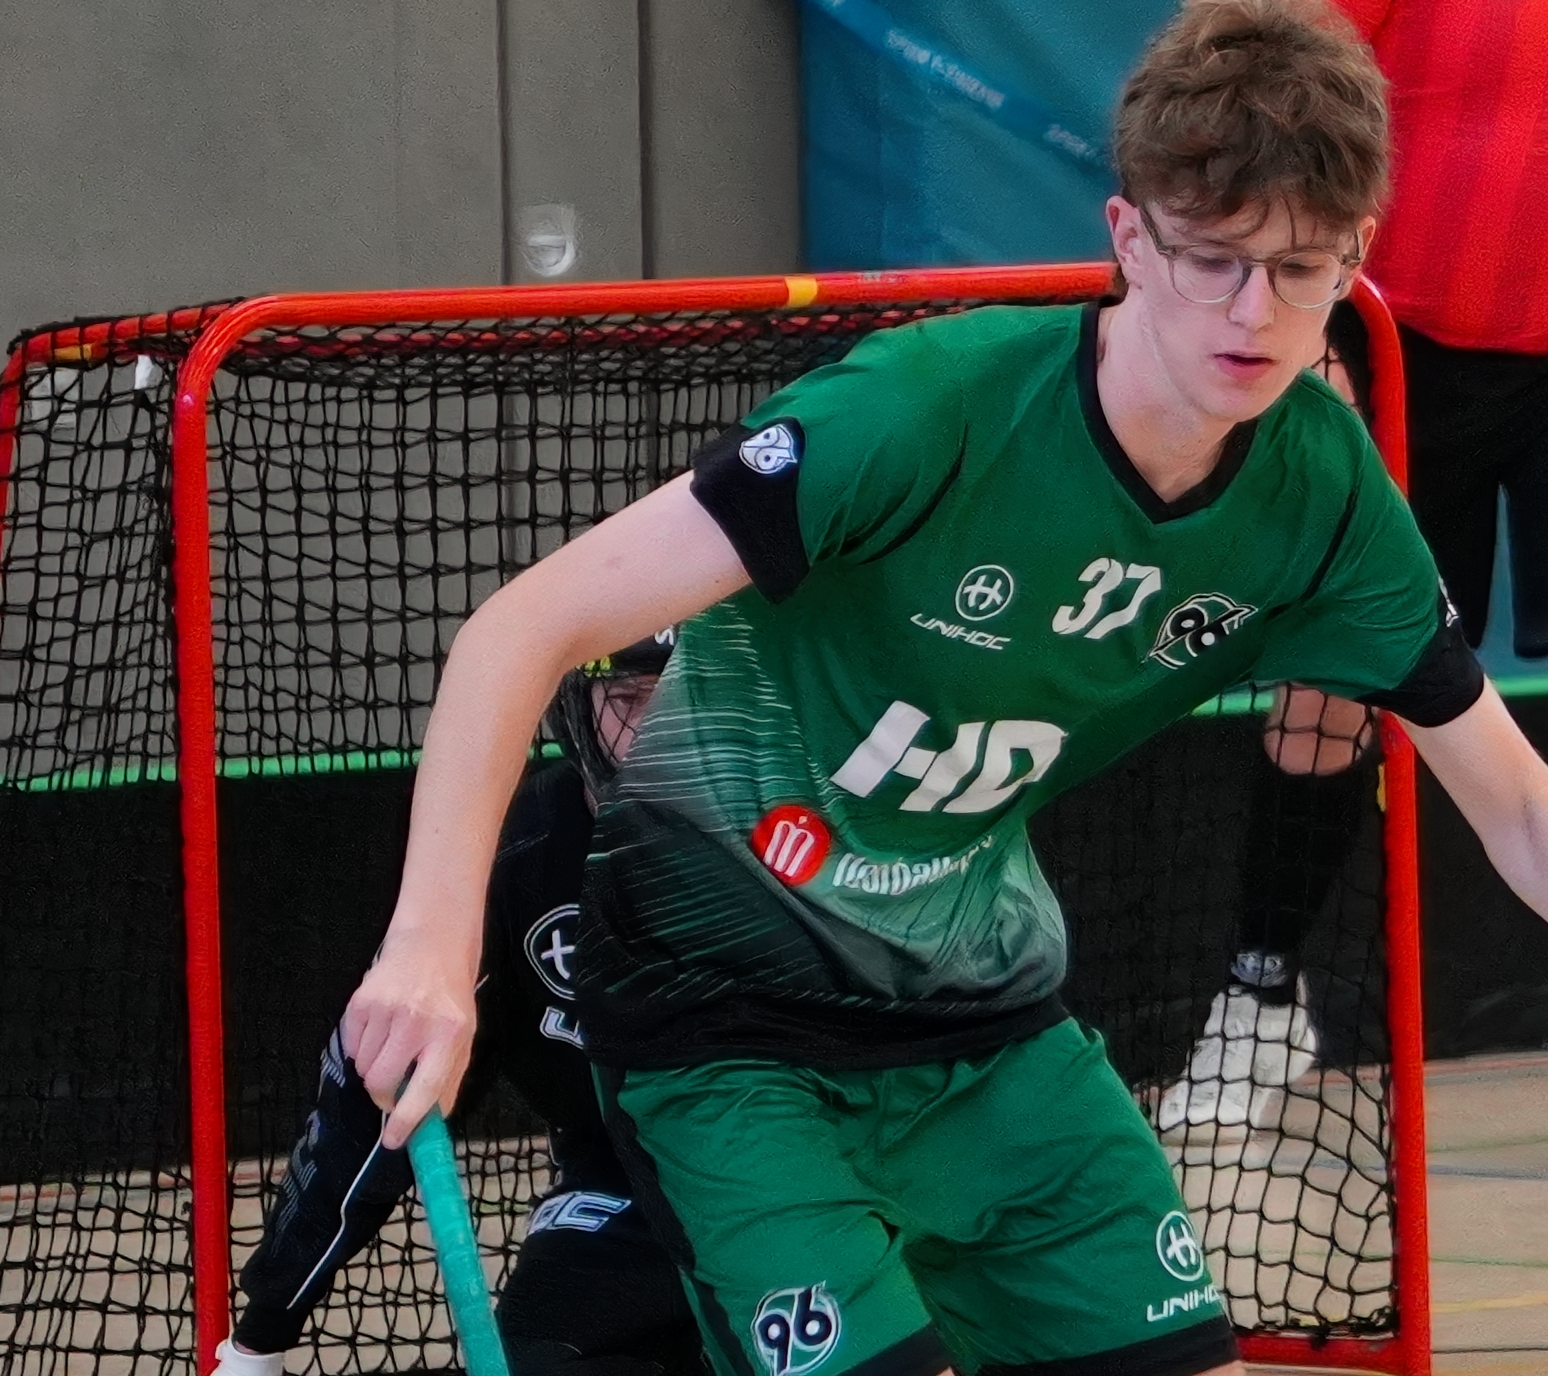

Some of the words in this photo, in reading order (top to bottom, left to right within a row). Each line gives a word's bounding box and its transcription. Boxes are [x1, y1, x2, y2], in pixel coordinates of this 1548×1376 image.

[910, 613, 1012, 650] UNIHOC
[1052, 557, 1162, 640] 37
[829, 699, 1069, 814] HD
